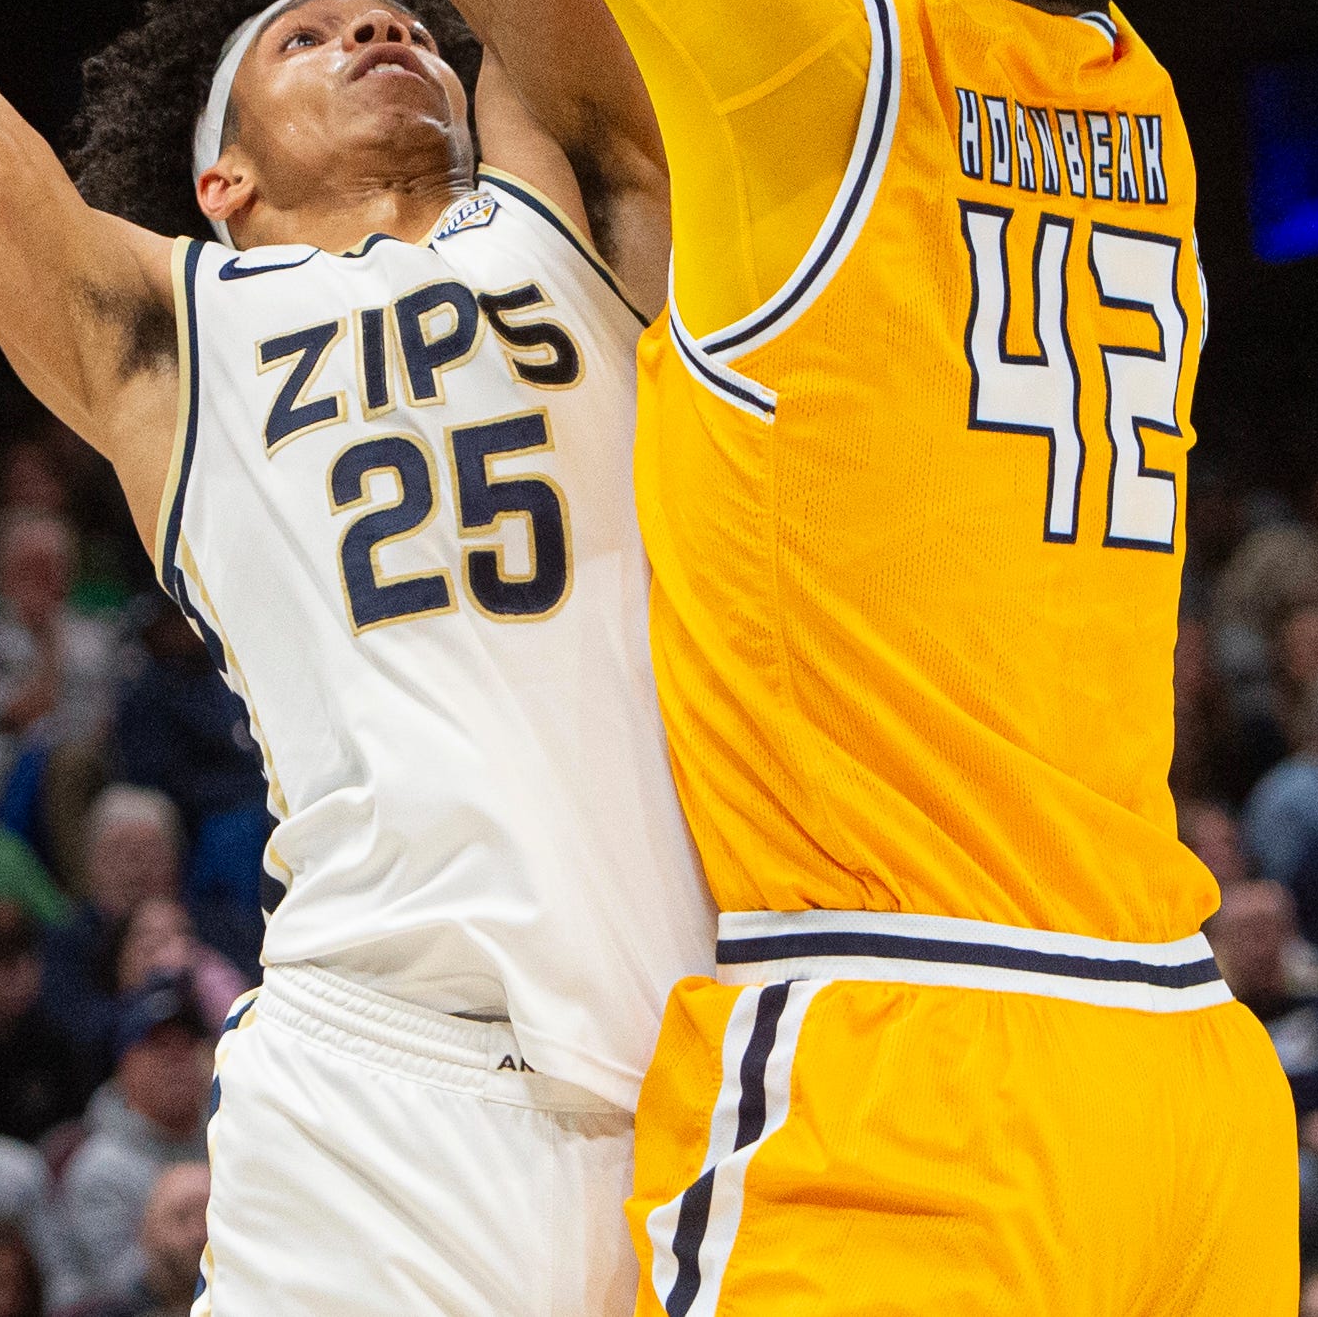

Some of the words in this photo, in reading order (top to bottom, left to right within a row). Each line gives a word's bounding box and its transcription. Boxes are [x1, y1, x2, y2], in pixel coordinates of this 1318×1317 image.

[955, 86, 1168, 205] HORNBEAK
[254, 277, 585, 458] ZIPS
[957, 198, 1188, 554] 42
[326, 405, 574, 637] 25
